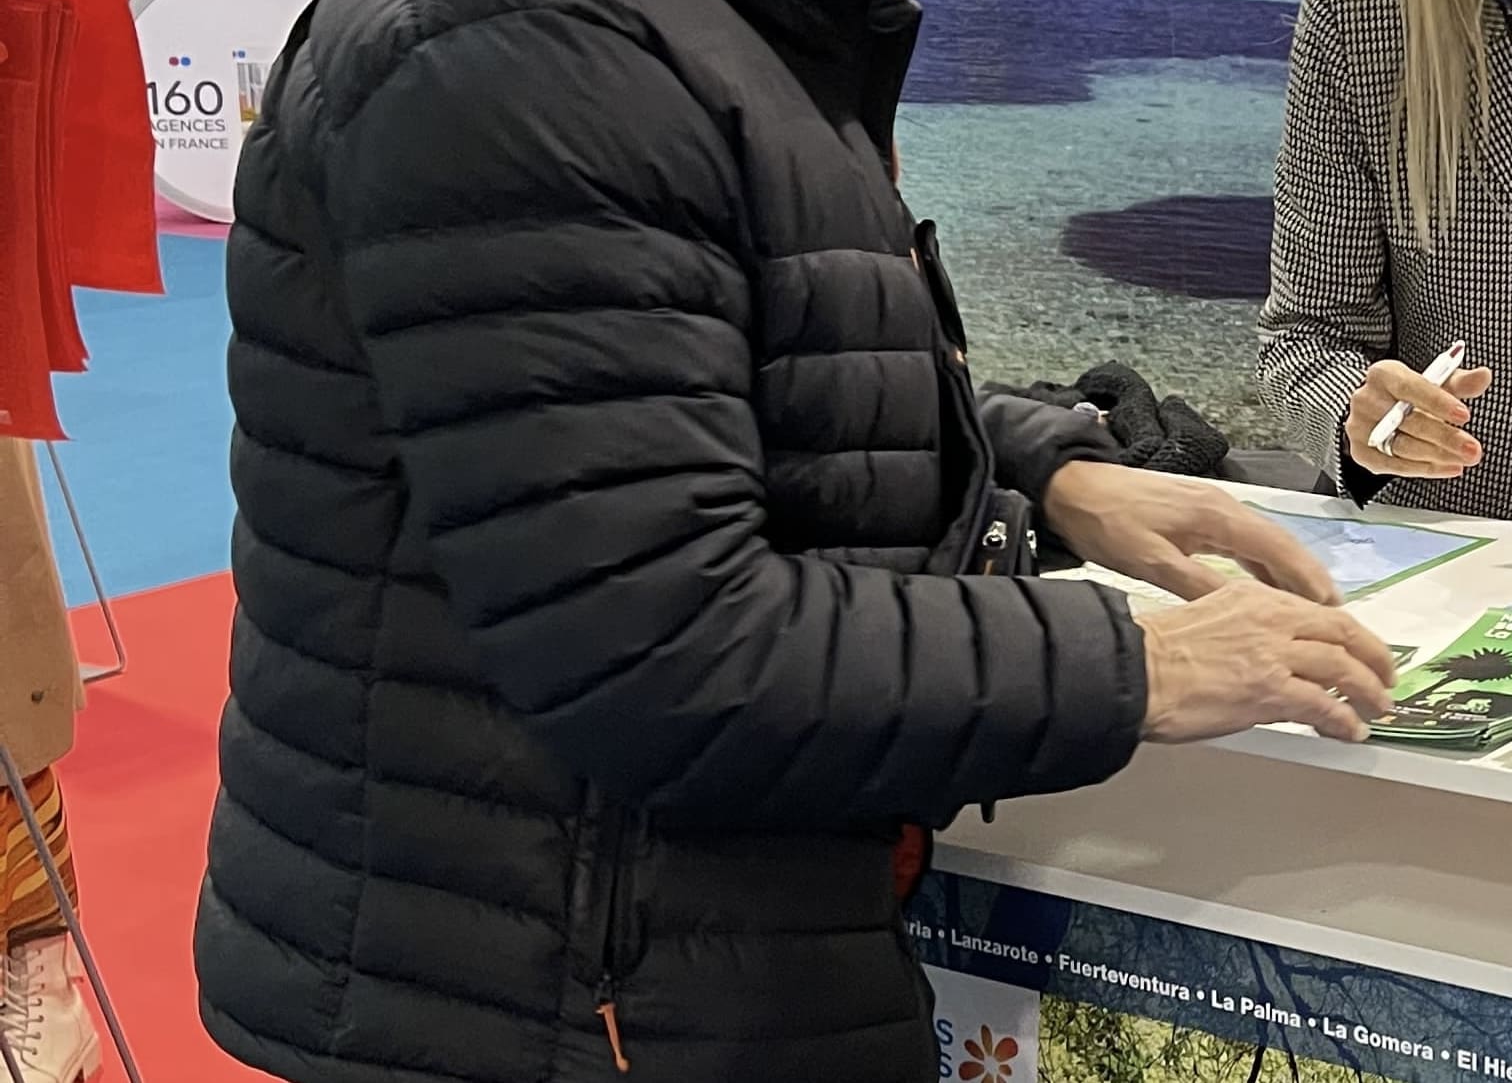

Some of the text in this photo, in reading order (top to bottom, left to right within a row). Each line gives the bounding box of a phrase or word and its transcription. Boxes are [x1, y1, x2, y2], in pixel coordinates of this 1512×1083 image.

[147, 80, 223, 116] 160
[169, 138, 229, 150] FRANCE
[1483, 629, 1512, 640] La
[951, 929, 1039, 965] Lanzarote
[1058, 953, 1190, 1001] Fuerteventura
[1210, 989, 1236, 1012] La
[1240, 996, 1301, 1029] Palma
[1322, 1016, 1348, 1040] La
[1353, 1024, 1435, 1062] Gomera
[1457, 1048, 1478, 1072] El
